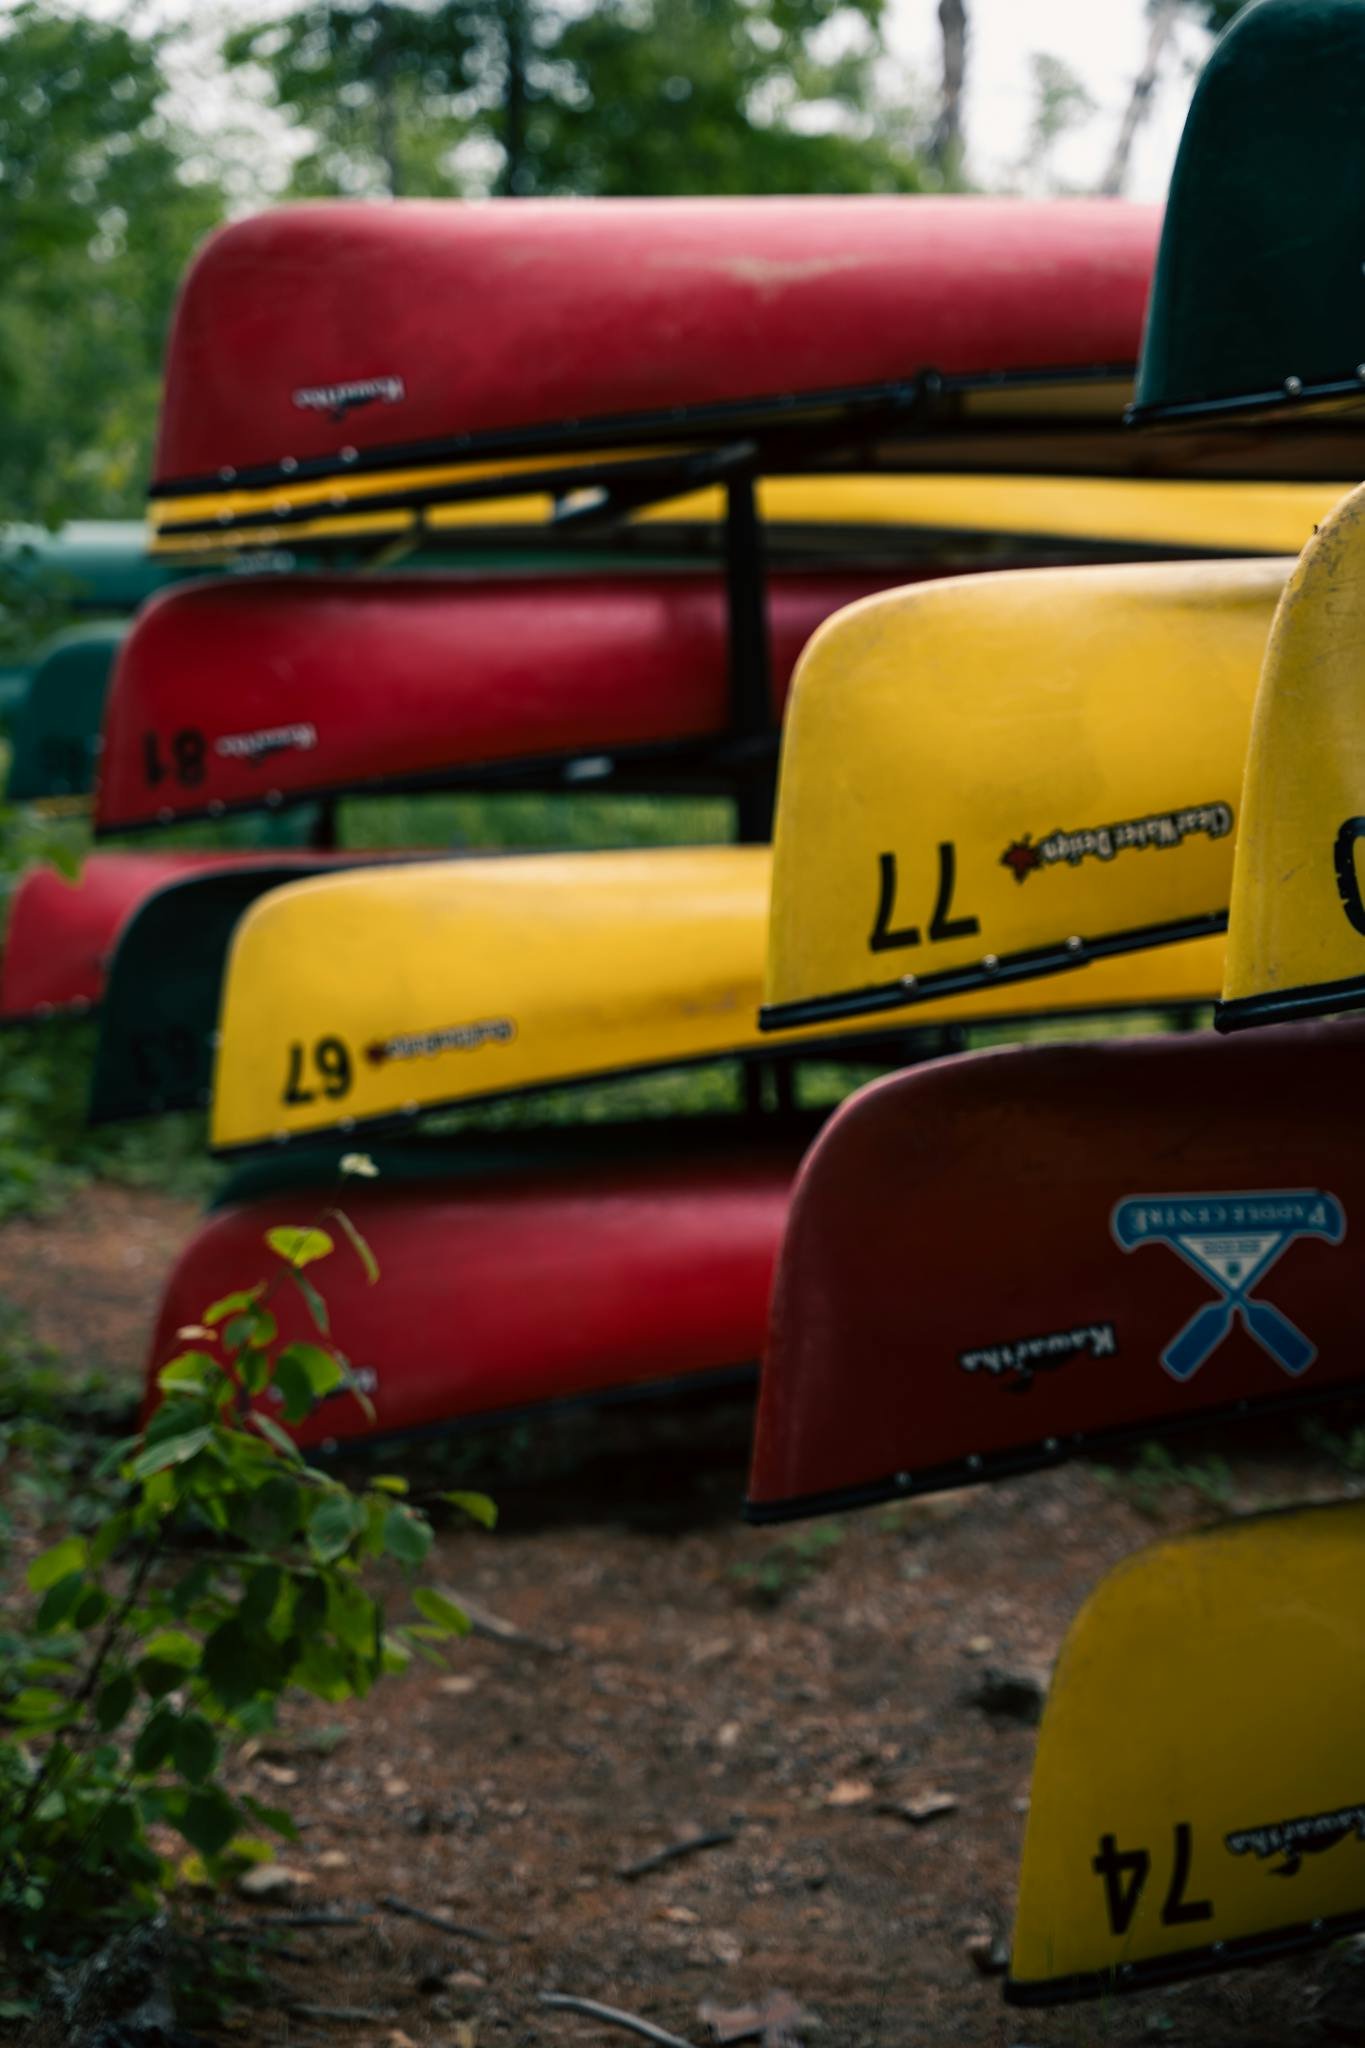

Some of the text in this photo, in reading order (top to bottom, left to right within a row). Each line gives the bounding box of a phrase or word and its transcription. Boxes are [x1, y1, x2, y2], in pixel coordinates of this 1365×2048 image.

[143, 727, 205, 788] 81
[1042, 829, 1115, 859] Design
[869, 841, 980, 953] 77
[281, 1035, 353, 1105] 67
[960, 1325, 1115, 1373] Kawartha
[1093, 1822, 1213, 1935] 74
